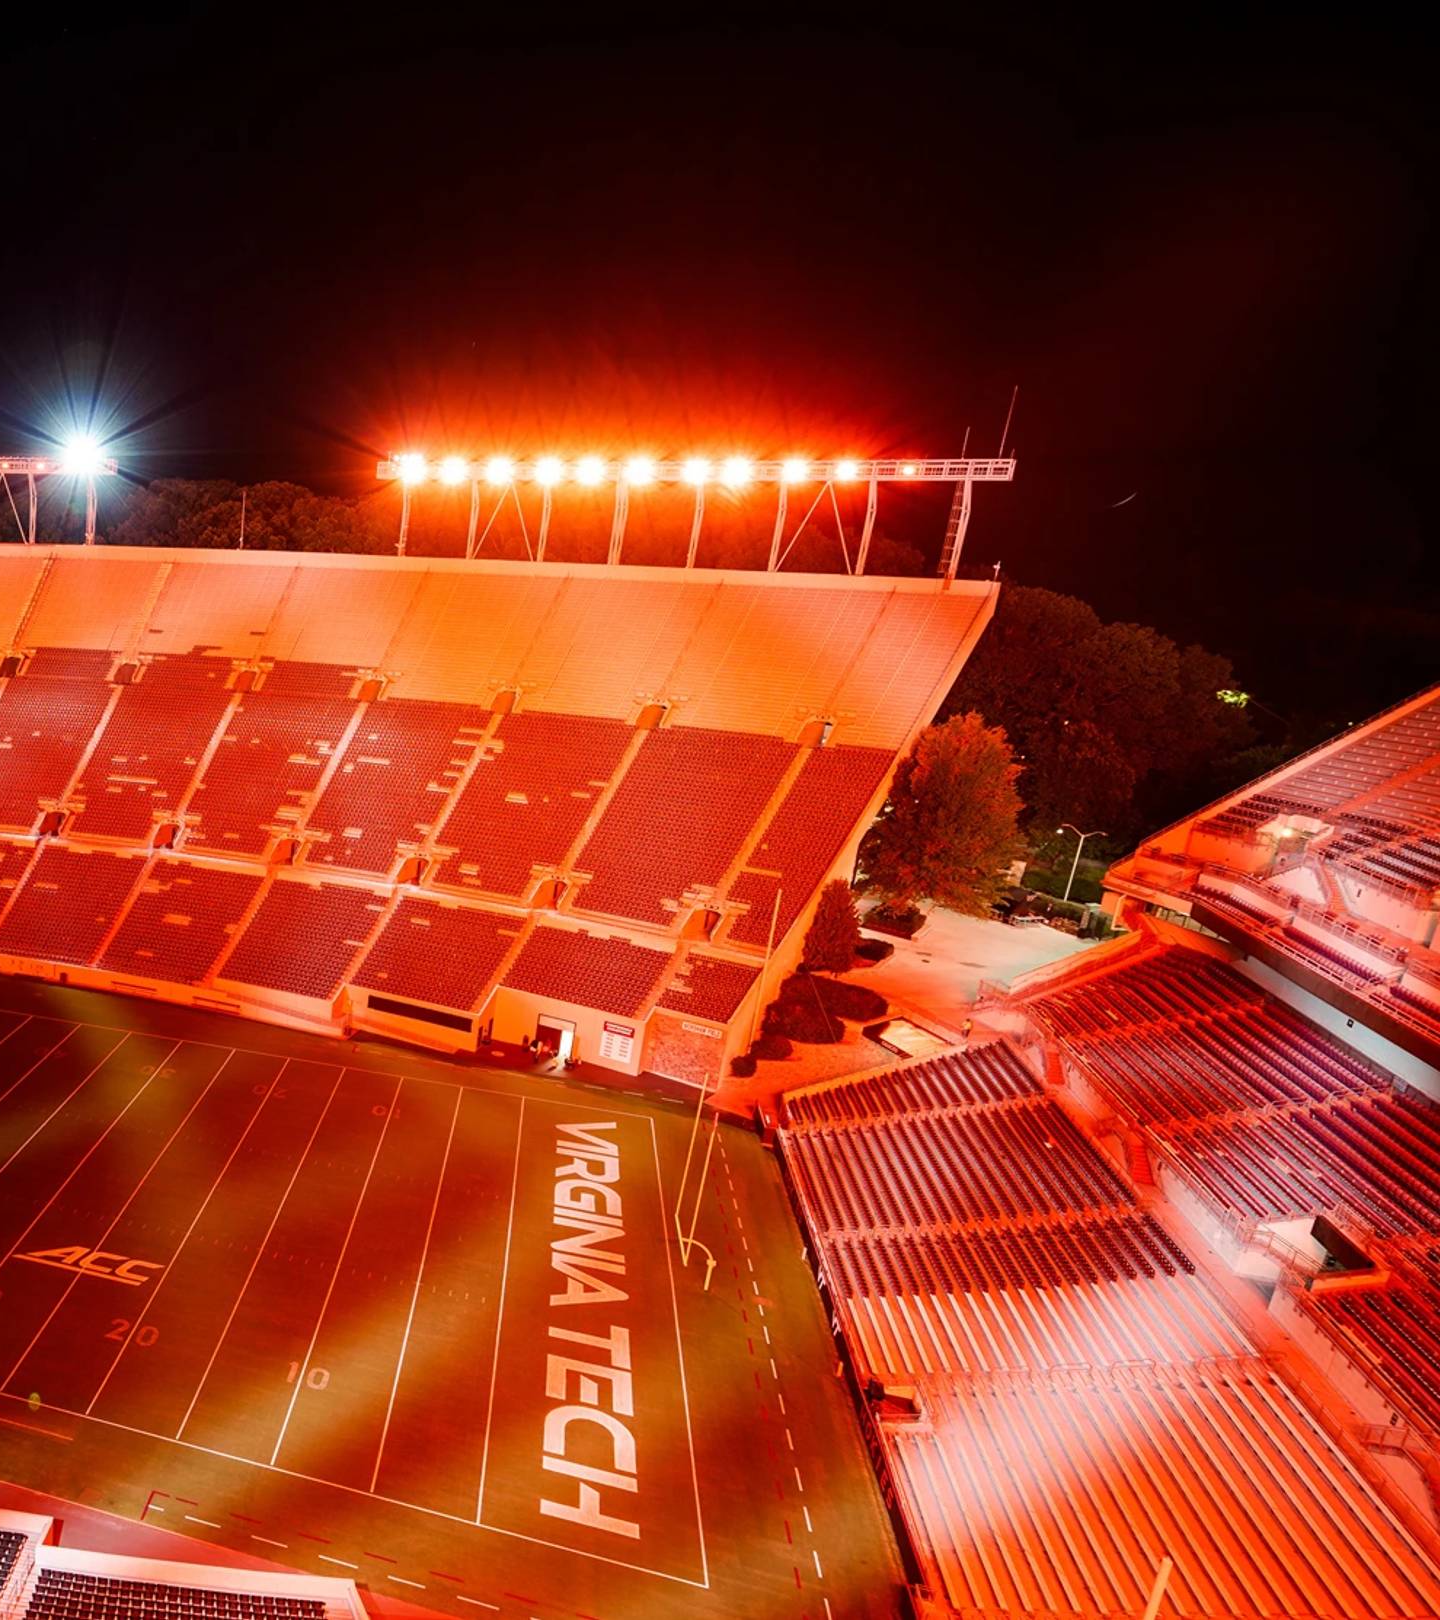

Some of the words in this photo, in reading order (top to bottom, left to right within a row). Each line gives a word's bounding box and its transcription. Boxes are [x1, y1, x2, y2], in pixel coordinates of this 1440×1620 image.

[549, 1121, 630, 1306] VIRGINIA
[13, 1245, 166, 1285] ACC
[103, 1318, 160, 1347] 20
[284, 1361, 331, 1391] 10
[539, 1325, 641, 1540] TECH
